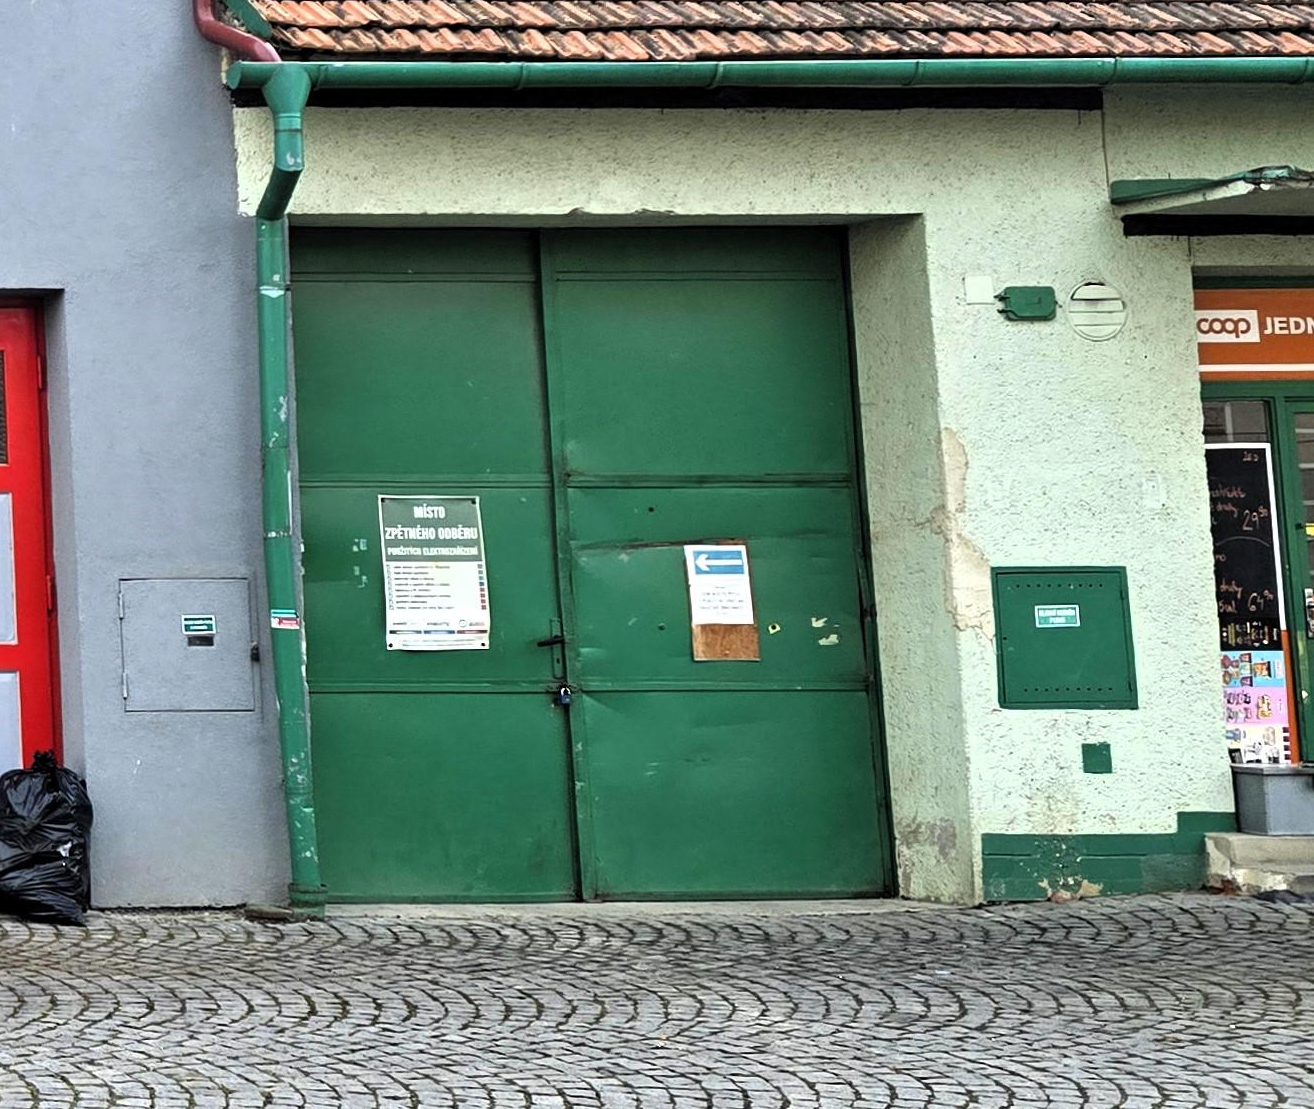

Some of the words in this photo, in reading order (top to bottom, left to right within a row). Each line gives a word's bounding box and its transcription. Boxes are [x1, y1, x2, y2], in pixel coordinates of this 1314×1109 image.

[1196, 317, 1251, 339] coop
[413, 503, 446, 519] MÍSTO
[384, 524, 436, 540] ZPĚTNÉHO
[437, 524, 478, 540] ODBĚRU
